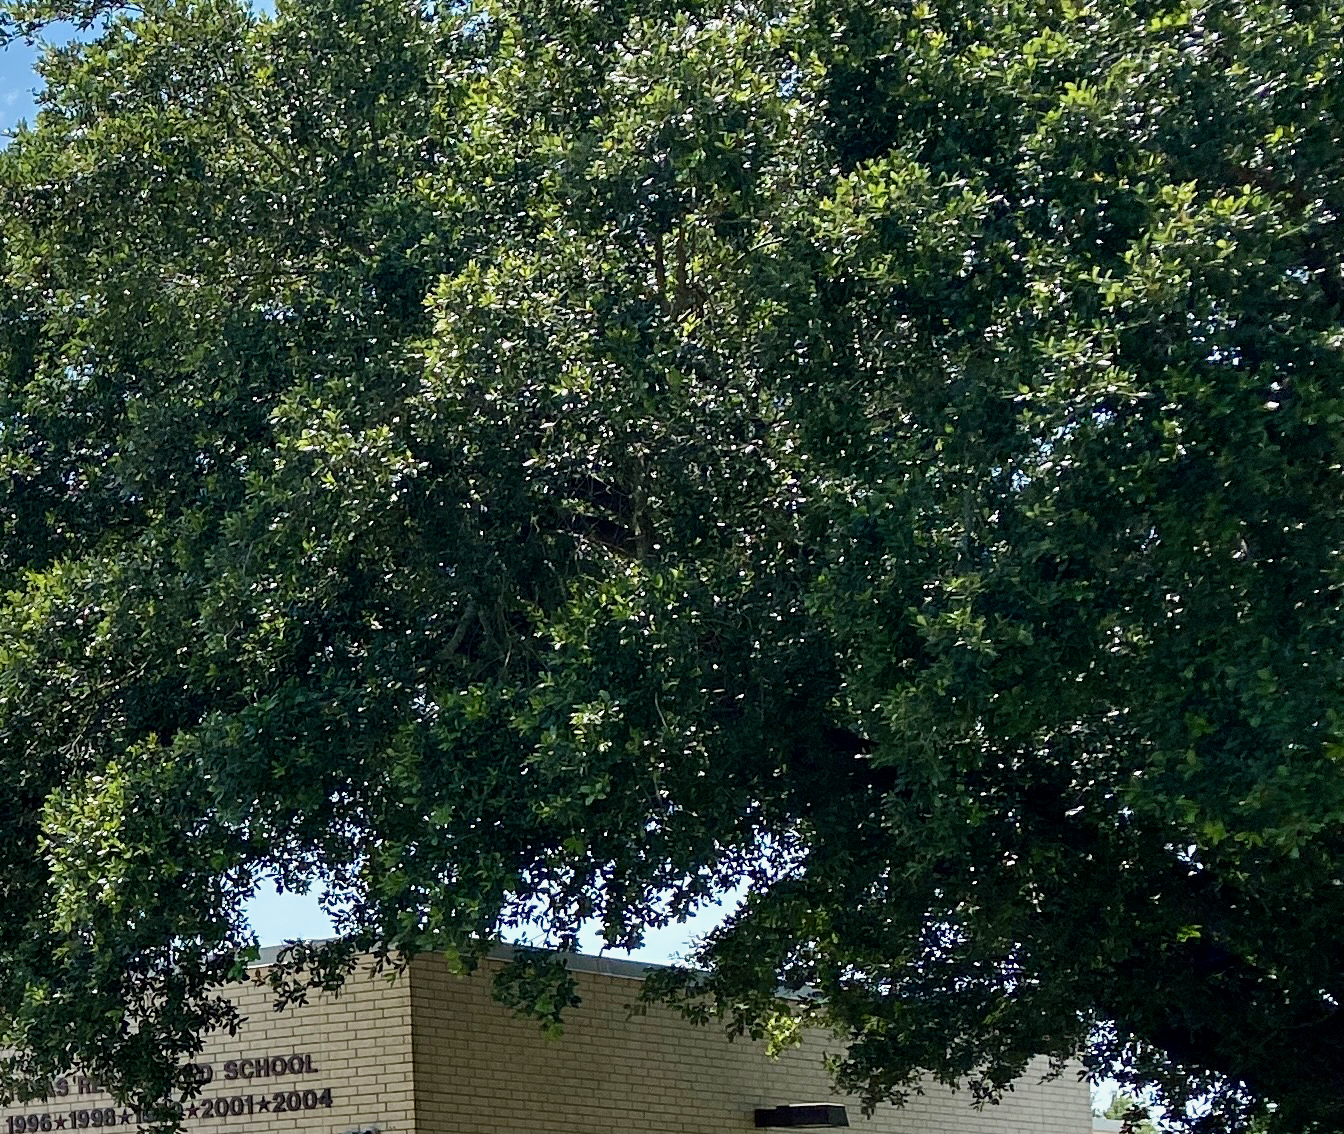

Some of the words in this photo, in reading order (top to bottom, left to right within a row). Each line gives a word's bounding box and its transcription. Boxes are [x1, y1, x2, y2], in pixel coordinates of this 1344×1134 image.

[224, 1055, 319, 1081] SCHOOL
[6, 1113, 52, 1134] 1996
[69, 1108, 116, 1129] 1998
[200, 1096, 254, 1118] 2001
[272, 1088, 333, 1113] 2004
